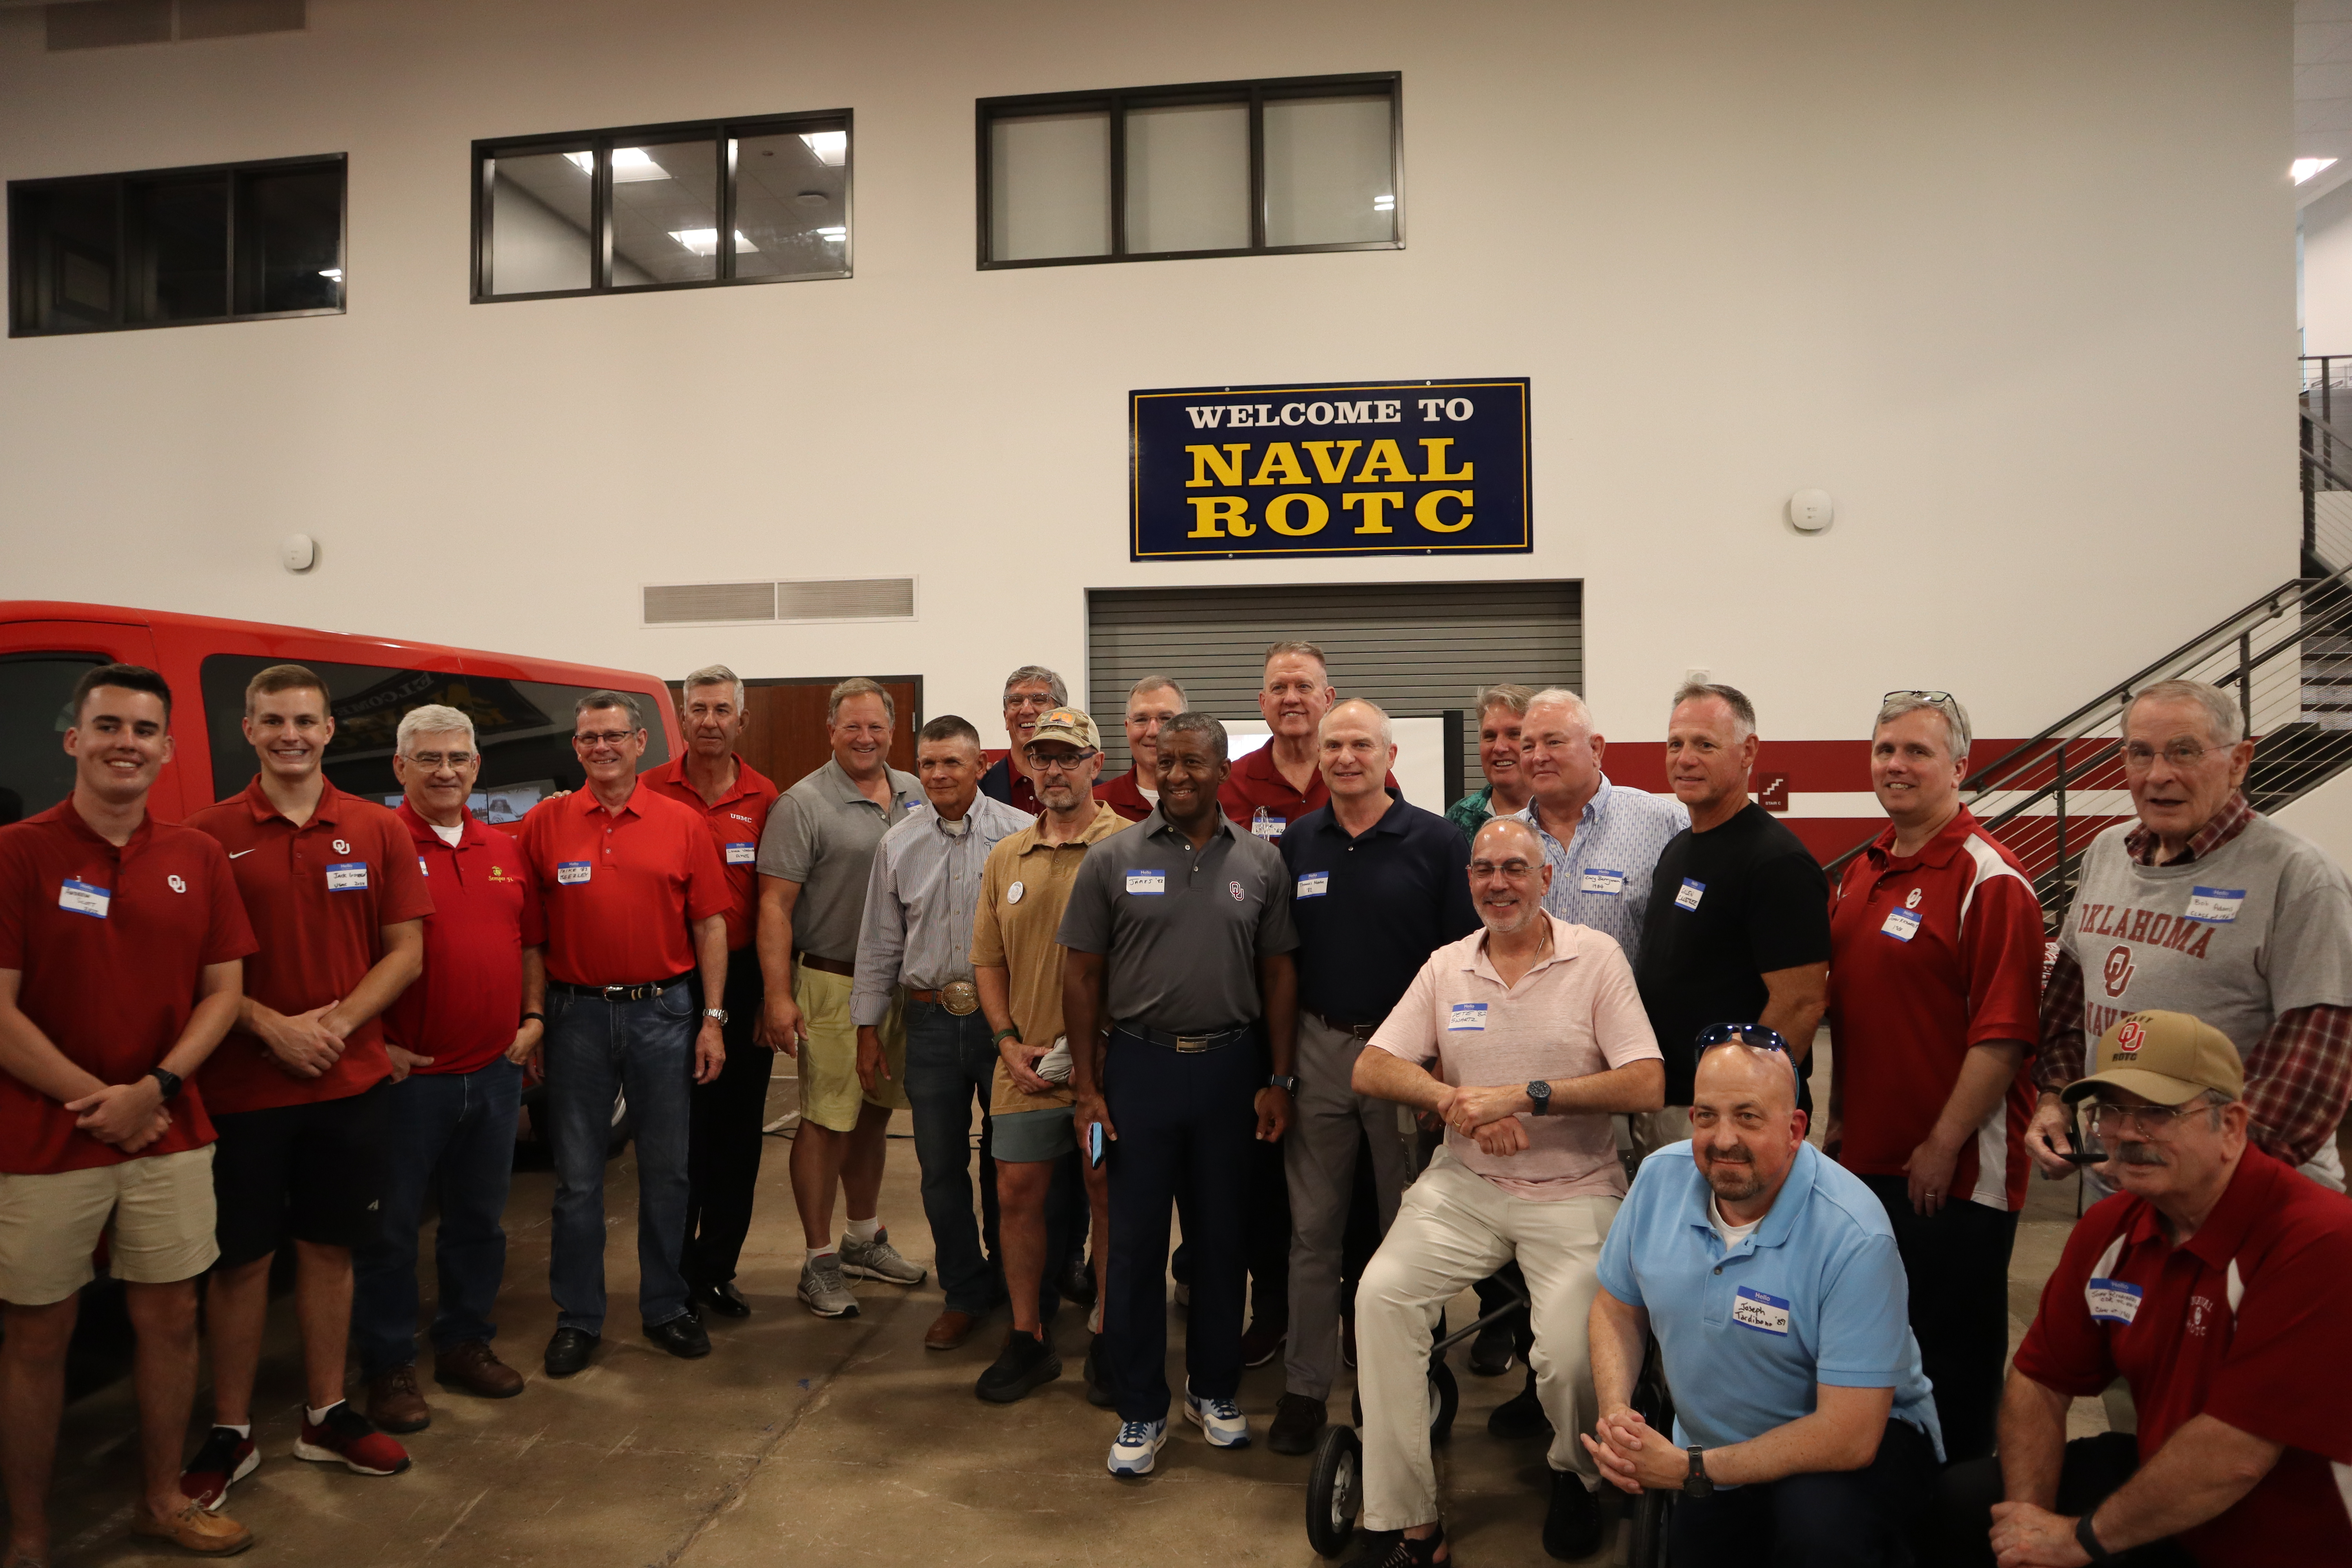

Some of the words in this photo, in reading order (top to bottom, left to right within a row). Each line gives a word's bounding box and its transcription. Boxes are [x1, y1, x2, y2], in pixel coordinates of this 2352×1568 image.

[1185, 400, 1401, 428] WELCOME
[1419, 397, 1474, 422] TO
[1185, 437, 1474, 487] NAVAL
[1187, 489, 1474, 538] ROTC
[730, 813, 752, 823] USMC
[332, 839, 350, 855] OU
[167, 875, 187, 893] OU
[1230, 881, 1244, 901] OU
[1906, 887, 1922, 909] OU
[2103, 944, 2136, 999] OU
[2118, 1021, 2146, 1053] OU
[2112, 1053, 2138, 1062] ROTC
[1755, 1292, 1771, 1301] Hello
[1739, 1302, 1765, 1316] Joseph
